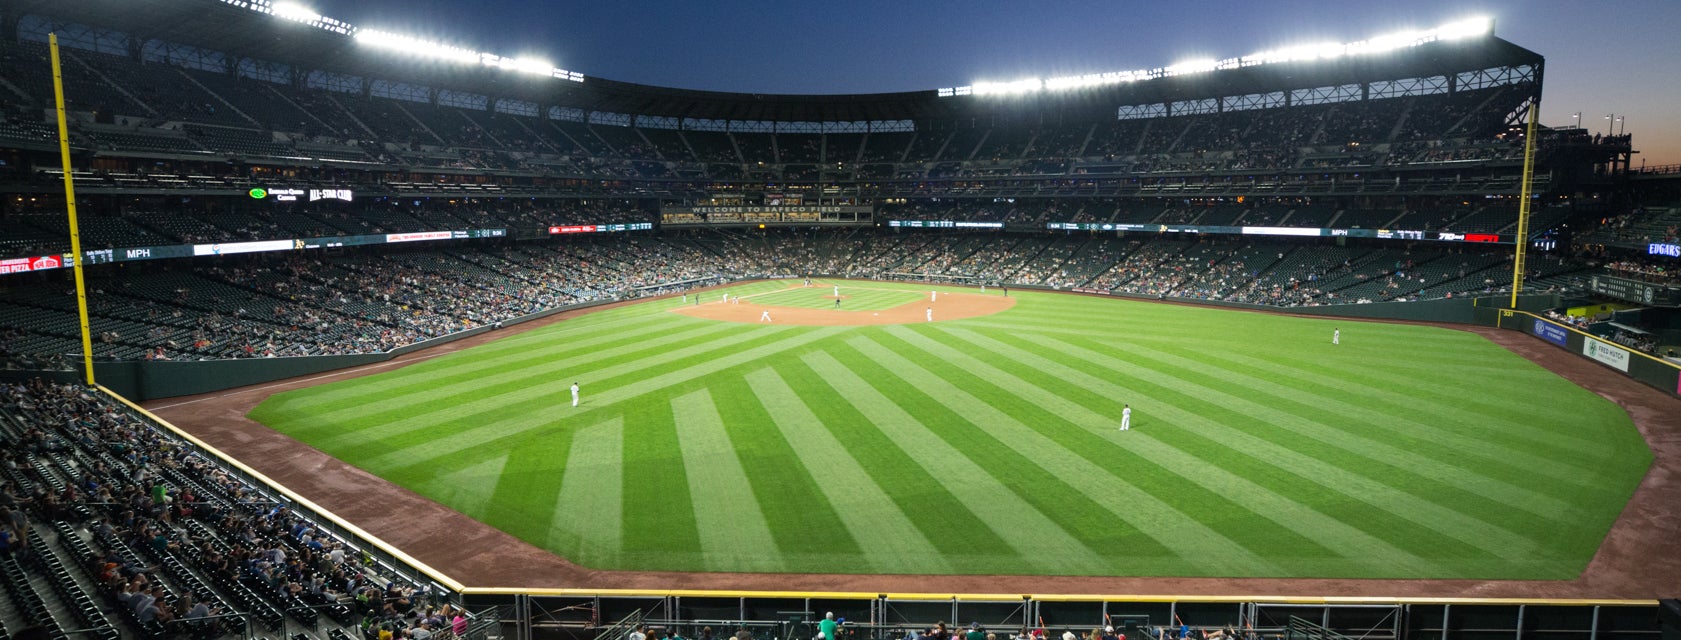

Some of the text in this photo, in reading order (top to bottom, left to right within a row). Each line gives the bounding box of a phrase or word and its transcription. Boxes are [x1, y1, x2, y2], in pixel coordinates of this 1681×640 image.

[337, 189, 352, 202] CLUB
[1438, 232, 1455, 240] 710
[126, 248, 151, 259] MPH
[1649, 243, 1681, 257] EDGARS
[1598, 345, 1609, 355] FRED
[1609, 349, 1624, 361] HUTCH
